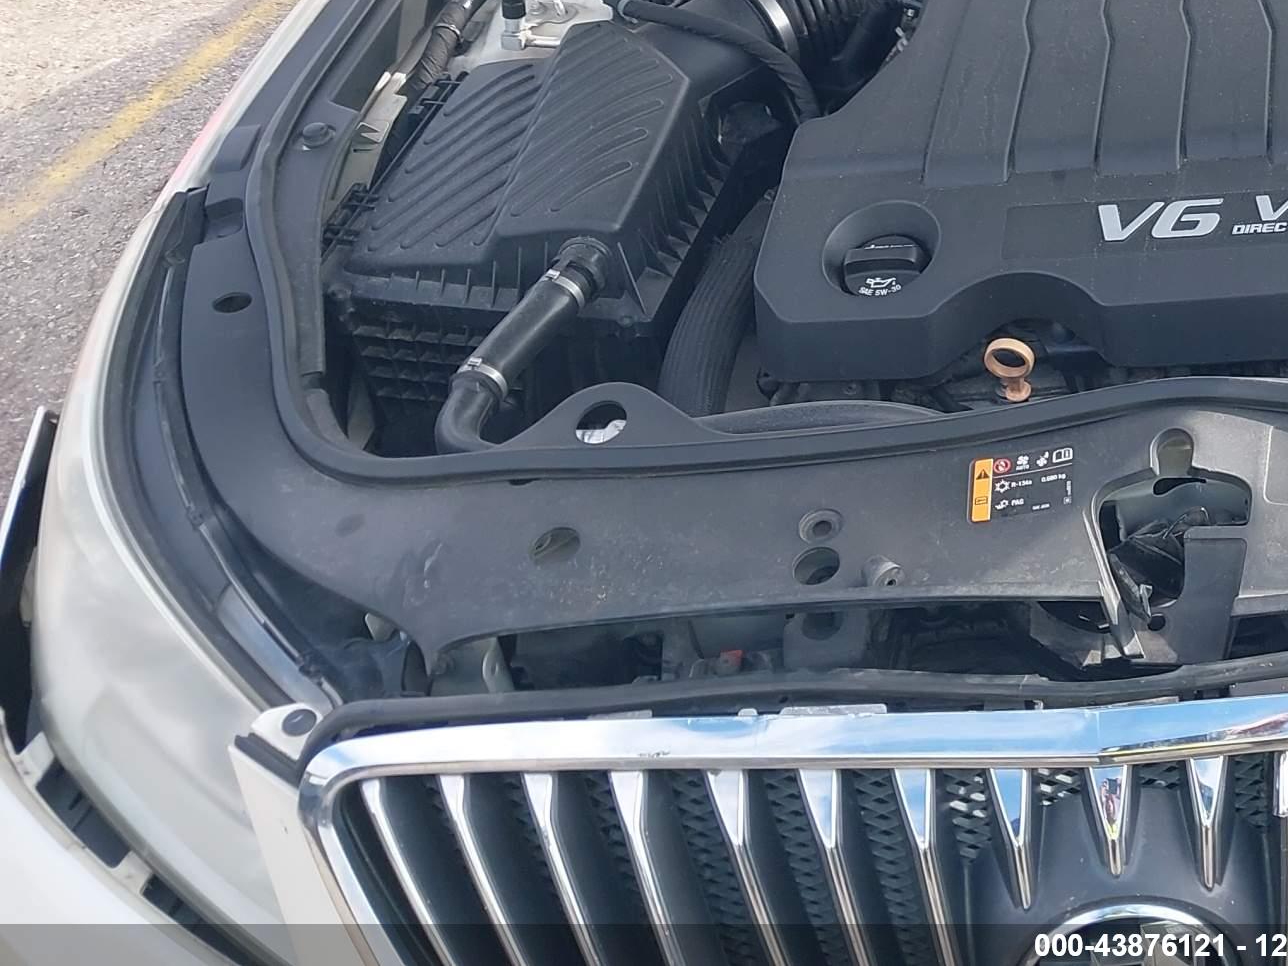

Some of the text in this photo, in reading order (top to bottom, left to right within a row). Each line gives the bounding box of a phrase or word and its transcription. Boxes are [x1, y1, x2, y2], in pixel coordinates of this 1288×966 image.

[1098, 198, 1224, 241] V6
[859, 284, 902, 296] SAE 5W-30
